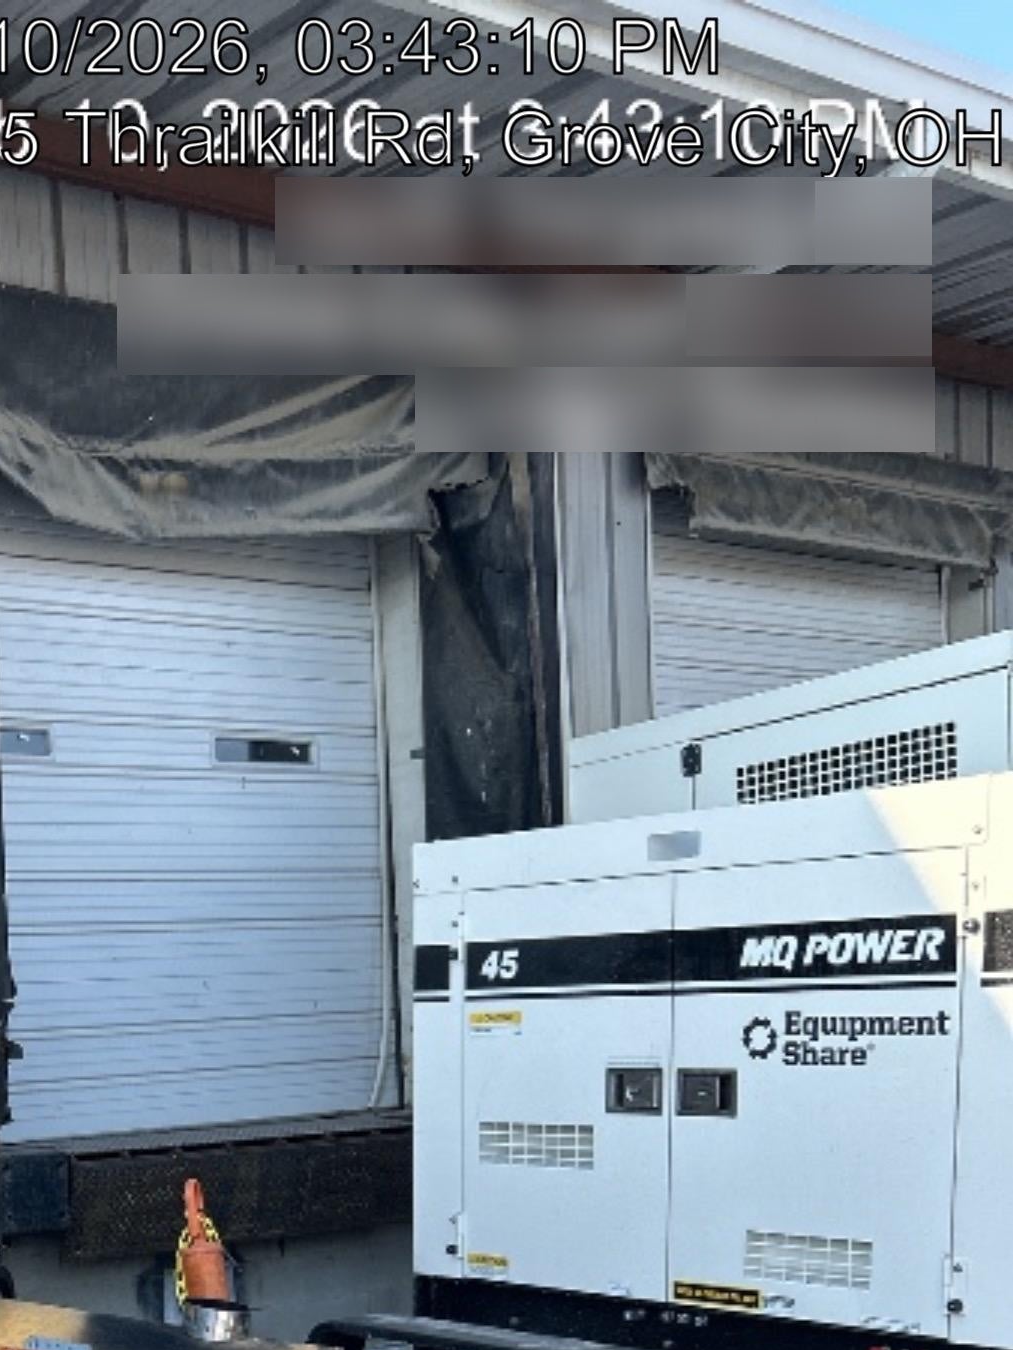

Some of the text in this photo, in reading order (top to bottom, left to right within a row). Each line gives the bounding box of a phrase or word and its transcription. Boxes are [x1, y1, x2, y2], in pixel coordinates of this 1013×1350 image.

[480, 948, 519, 979] 45
[740, 928, 945, 972] MQ POWER
[784, 1010, 951, 1042] Equipment
